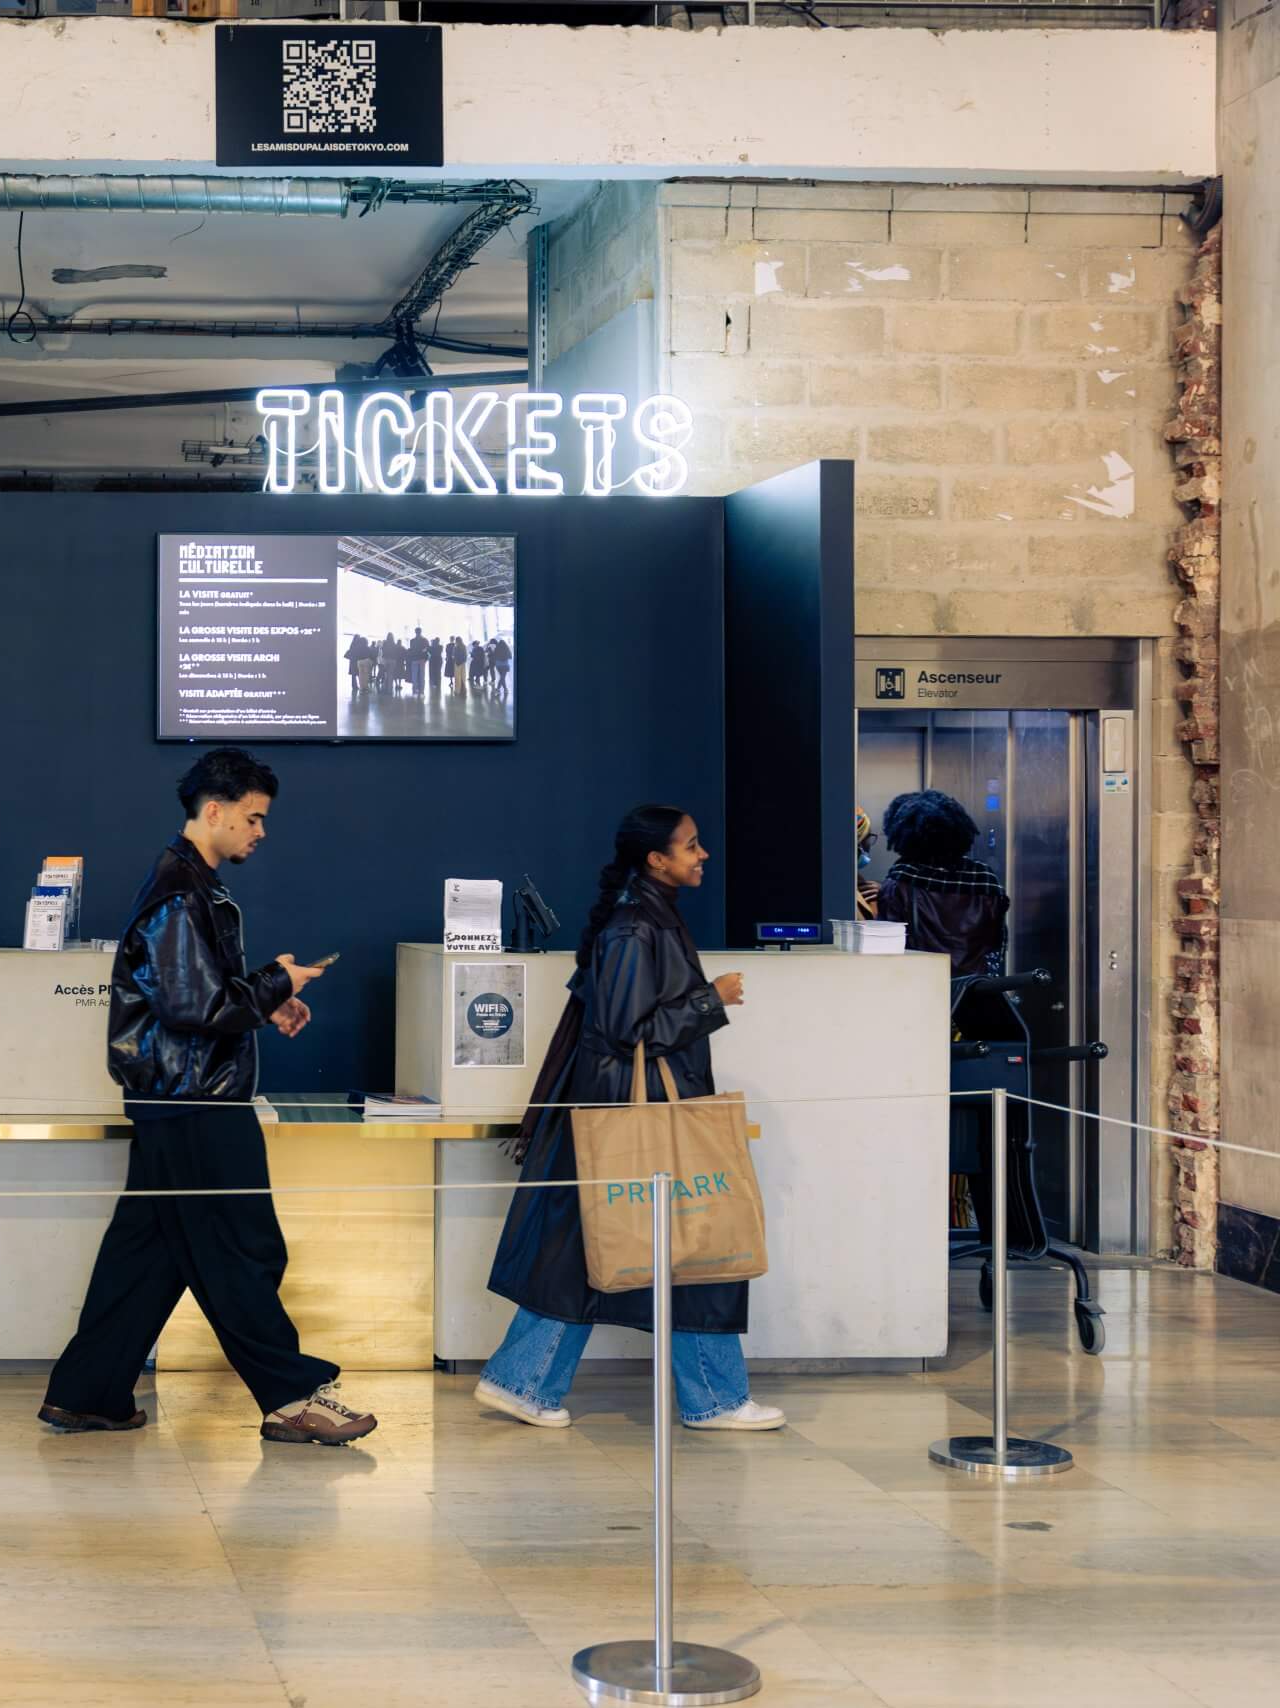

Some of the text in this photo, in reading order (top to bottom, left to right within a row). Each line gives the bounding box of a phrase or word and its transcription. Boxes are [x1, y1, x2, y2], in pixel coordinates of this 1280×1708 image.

[251, 143, 409, 152] LESAMISDUPALAISDETOKYO.COM
[256, 389, 694, 496] TICKETS
[179, 542, 255, 560] MÉDIATION
[179, 560, 263, 575] CULTURELLE
[179, 590, 191, 599] LA
[191, 590, 219, 599] VISITE
[179, 627, 190, 635] LA
[191, 627, 225, 635] GROSSE
[227, 627, 252, 635] VISITE
[253, 627, 269, 635] DES
[270, 627, 299, 635] EXPOS
[179, 654, 280, 662] LA GROSSE VISITE ARCHI
[917, 670, 1002, 684] Ascenseur
[179, 690, 205, 698] VISITE
[206, 687, 243, 698] ADAPTÉE
[917, 688, 958, 698] Elevator
[54, 984, 95, 995] Accès
[75, 999, 97, 1007] PMR
[474, 1003, 499, 1012] WIFI
[607, 1171, 730, 1205] PRIARK
